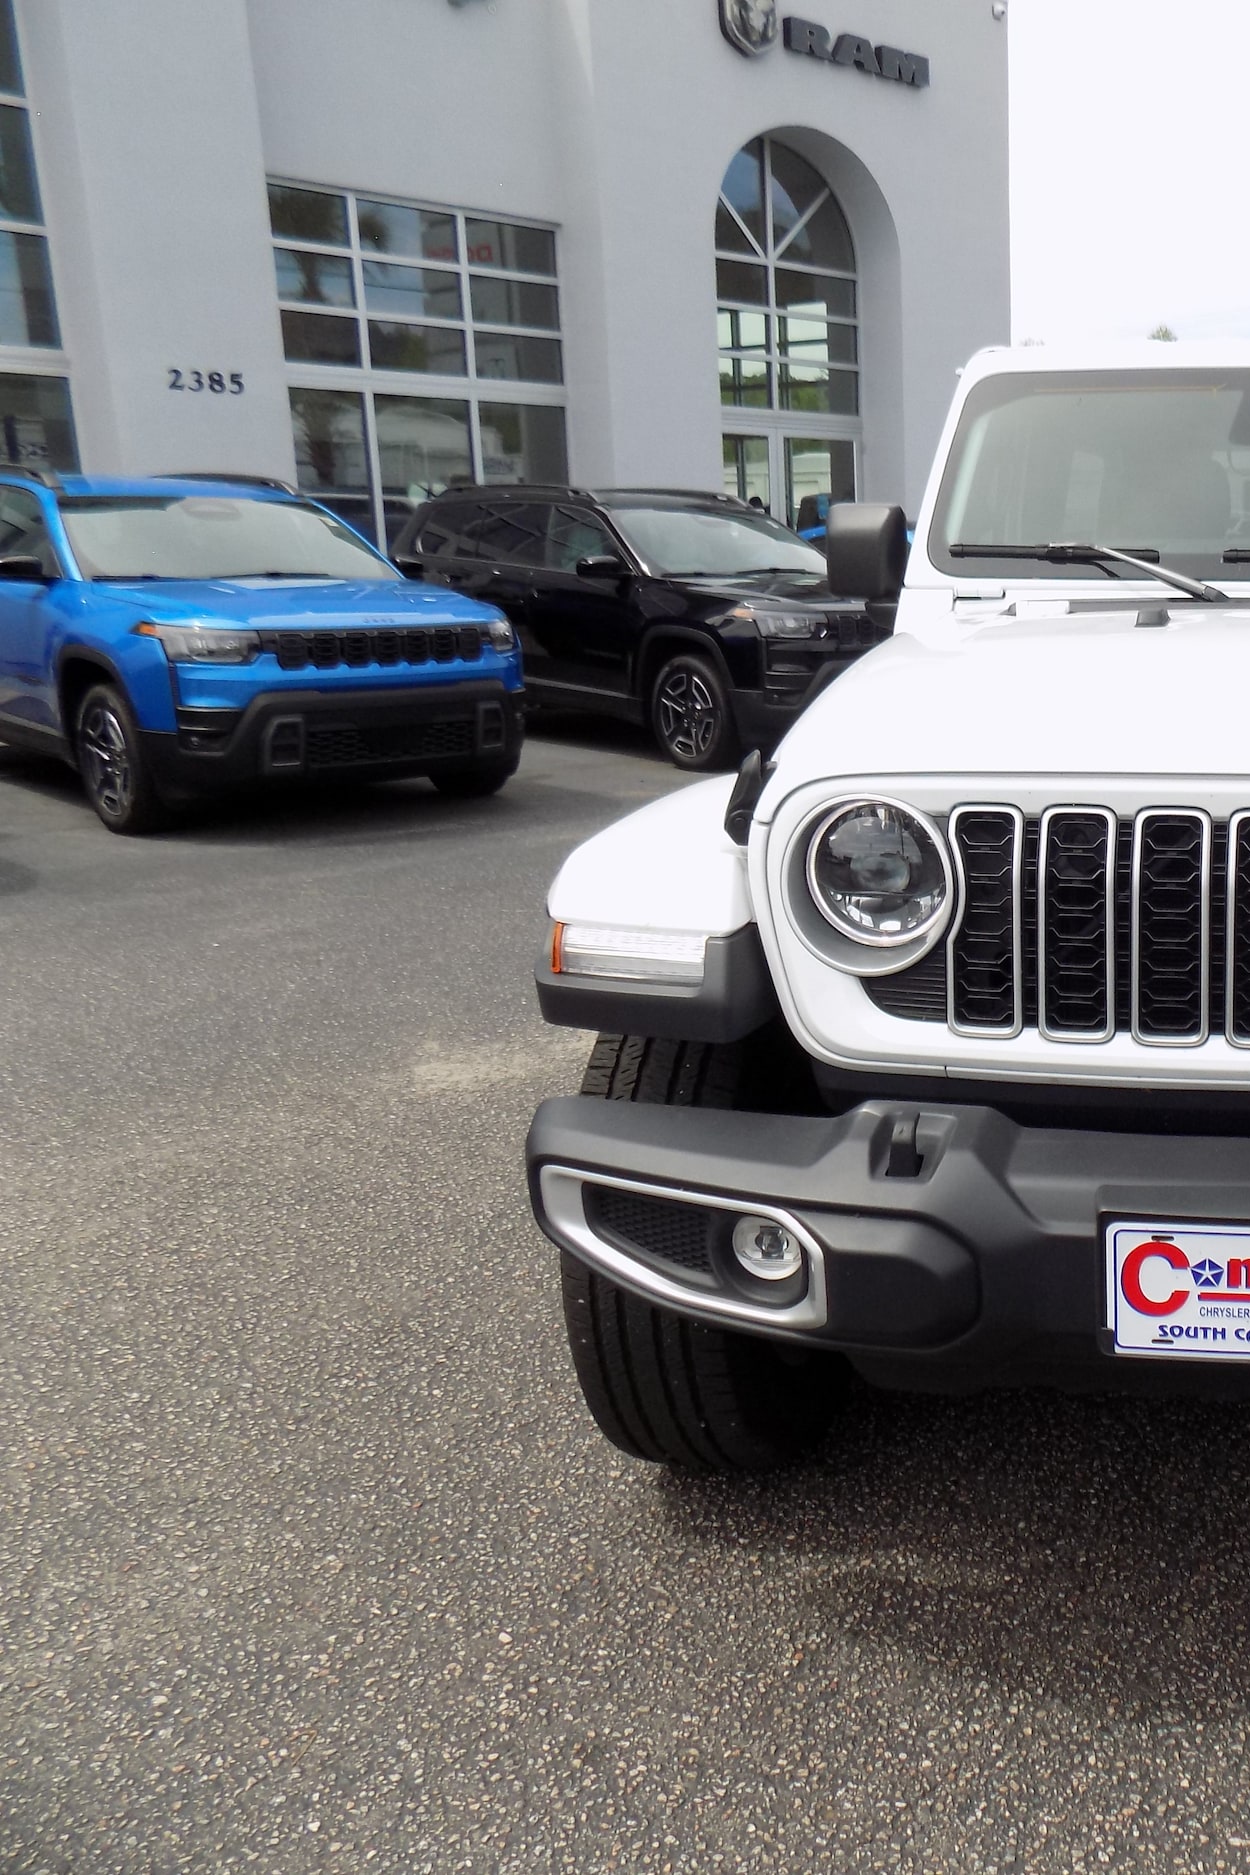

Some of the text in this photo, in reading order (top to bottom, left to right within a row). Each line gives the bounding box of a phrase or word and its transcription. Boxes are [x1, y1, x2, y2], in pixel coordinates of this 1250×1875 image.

[783, 16, 931, 88] RAM
[167, 368, 245, 395] 2385
[1199, 1306, 1250, 1319] CHRYSLER
[1158, 1324, 1226, 1342] SOUTH
